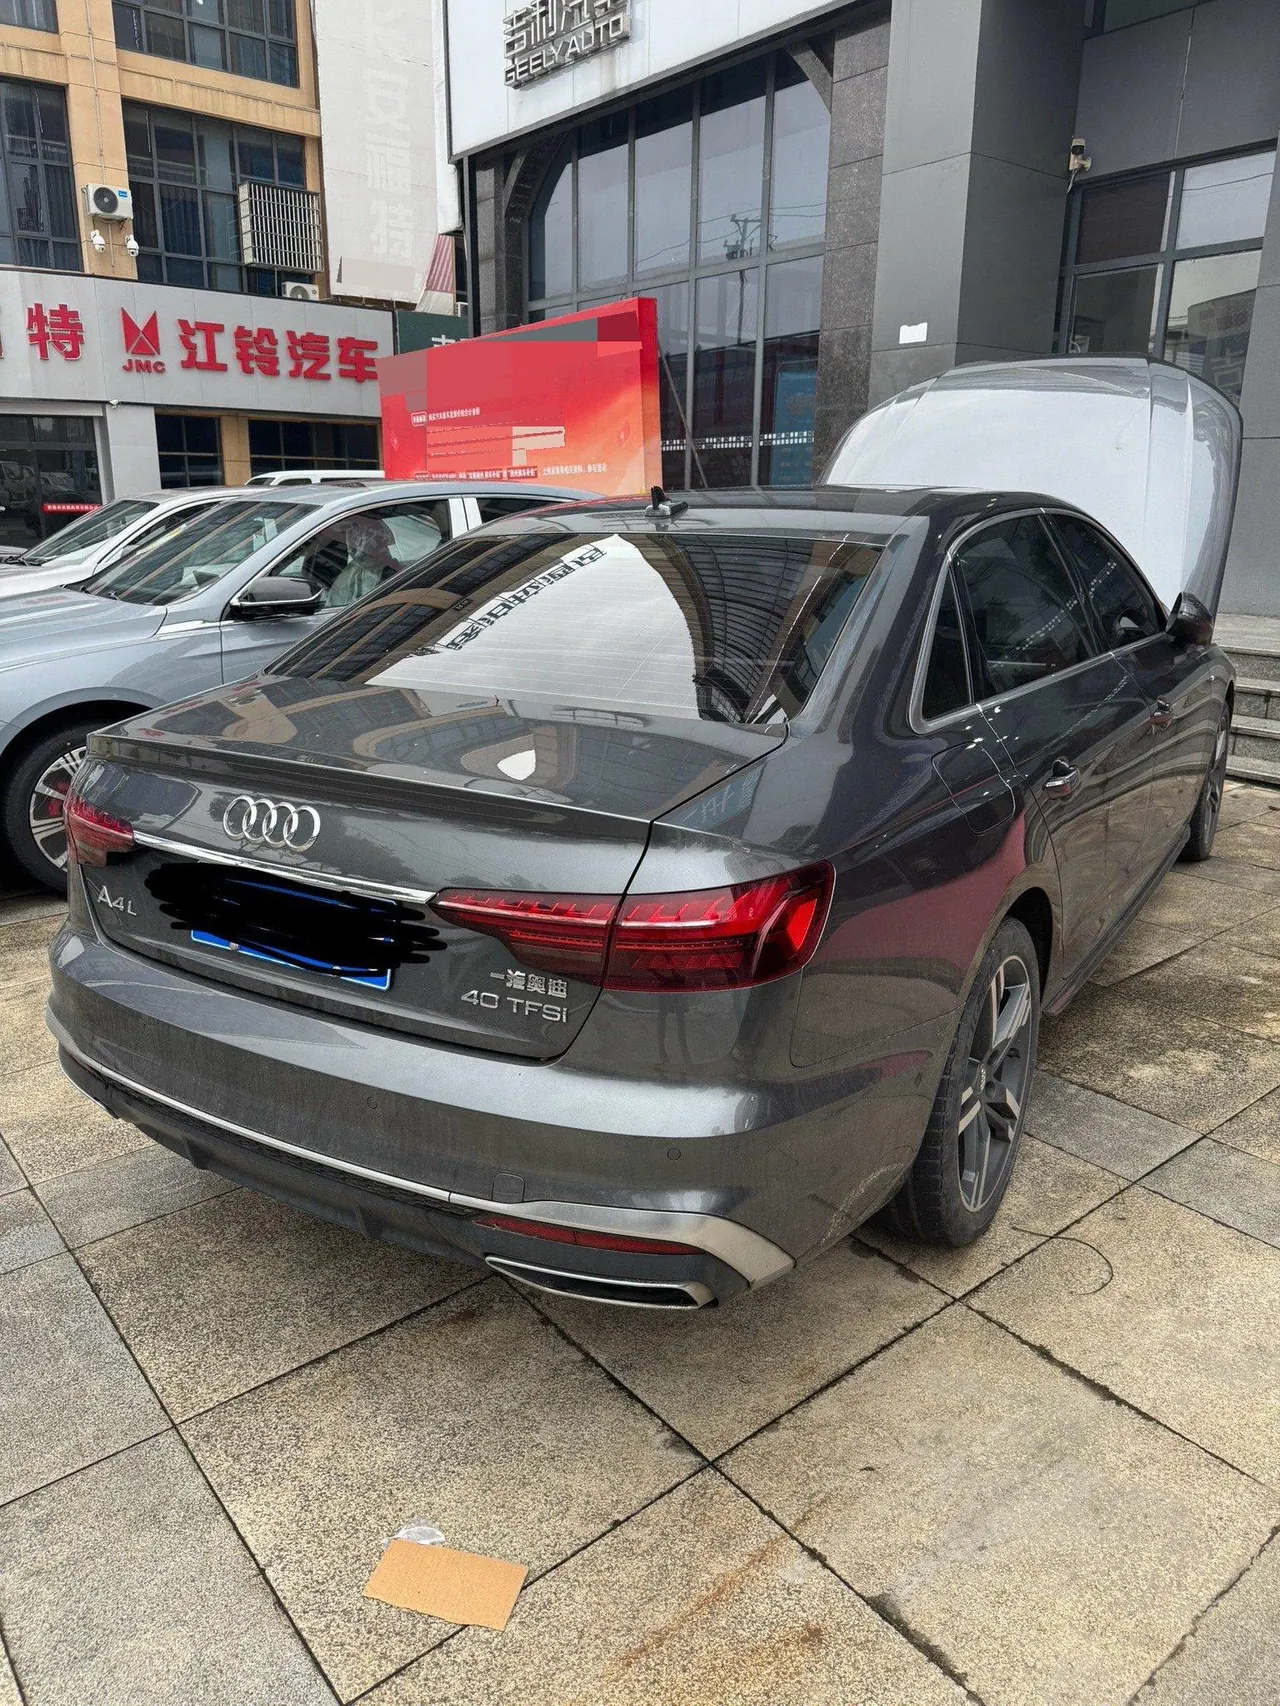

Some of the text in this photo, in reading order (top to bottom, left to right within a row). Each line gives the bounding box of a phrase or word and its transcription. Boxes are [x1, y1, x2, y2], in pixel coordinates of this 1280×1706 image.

[122, 358, 166, 373] JMC
[177, 319, 378, 383] 江铃汽车
[97, 884, 137, 916] A4L
[490, 969, 567, 998] 一汽奥迪
[461, 990, 499, 1009] 40
